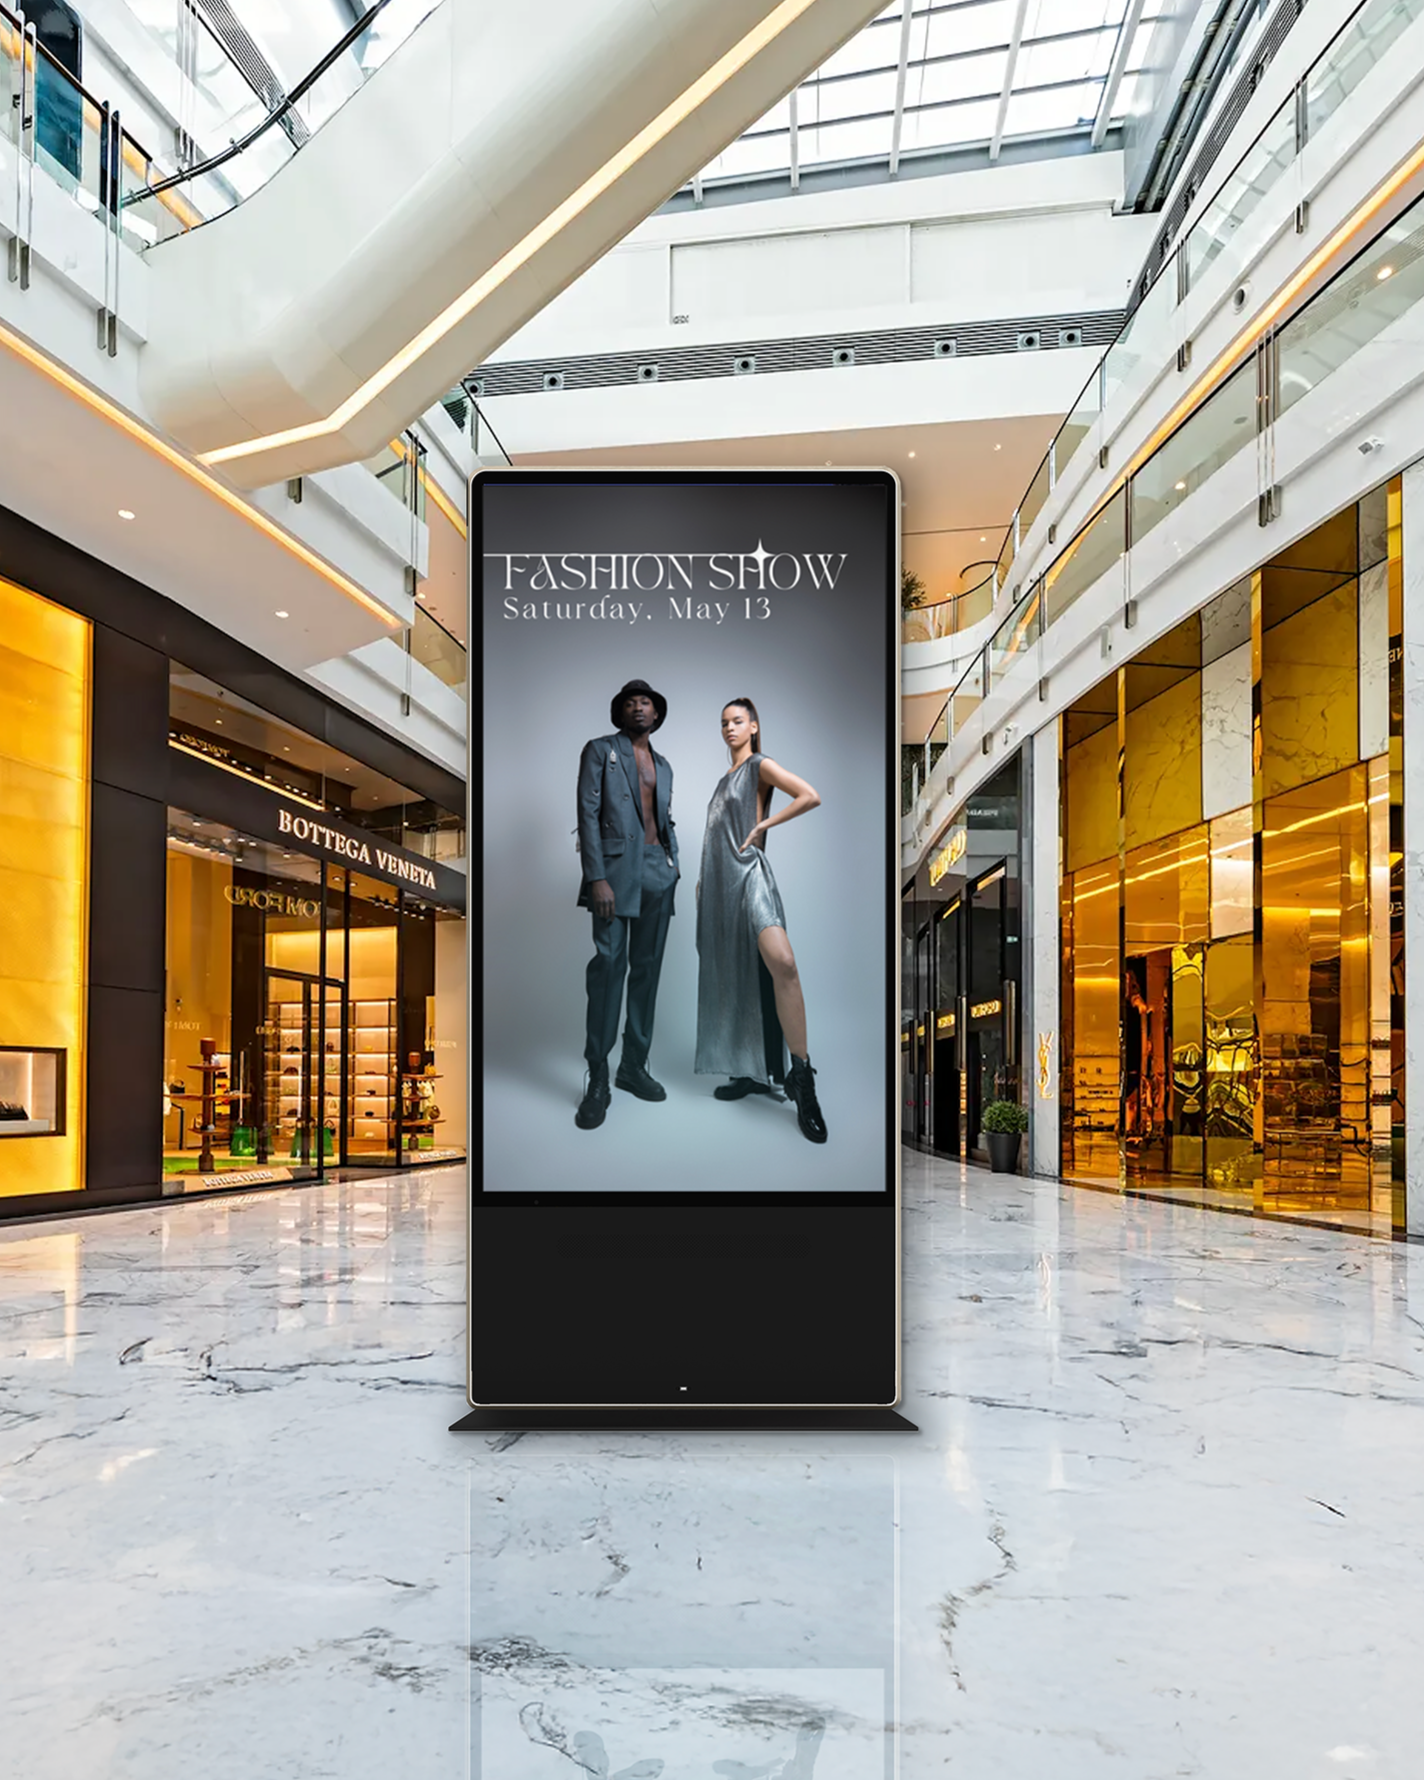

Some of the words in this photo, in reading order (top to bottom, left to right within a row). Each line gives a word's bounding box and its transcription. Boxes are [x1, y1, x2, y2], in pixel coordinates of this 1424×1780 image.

[503, 553, 694, 591] FASHION
[708, 553, 849, 591] SHOW
[503, 594, 653, 625] Saturday,
[668, 596, 731, 625] May
[743, 596, 772, 620] 13
[277, 809, 372, 865] BOTTEGA
[375, 848, 437, 890] VENETA
